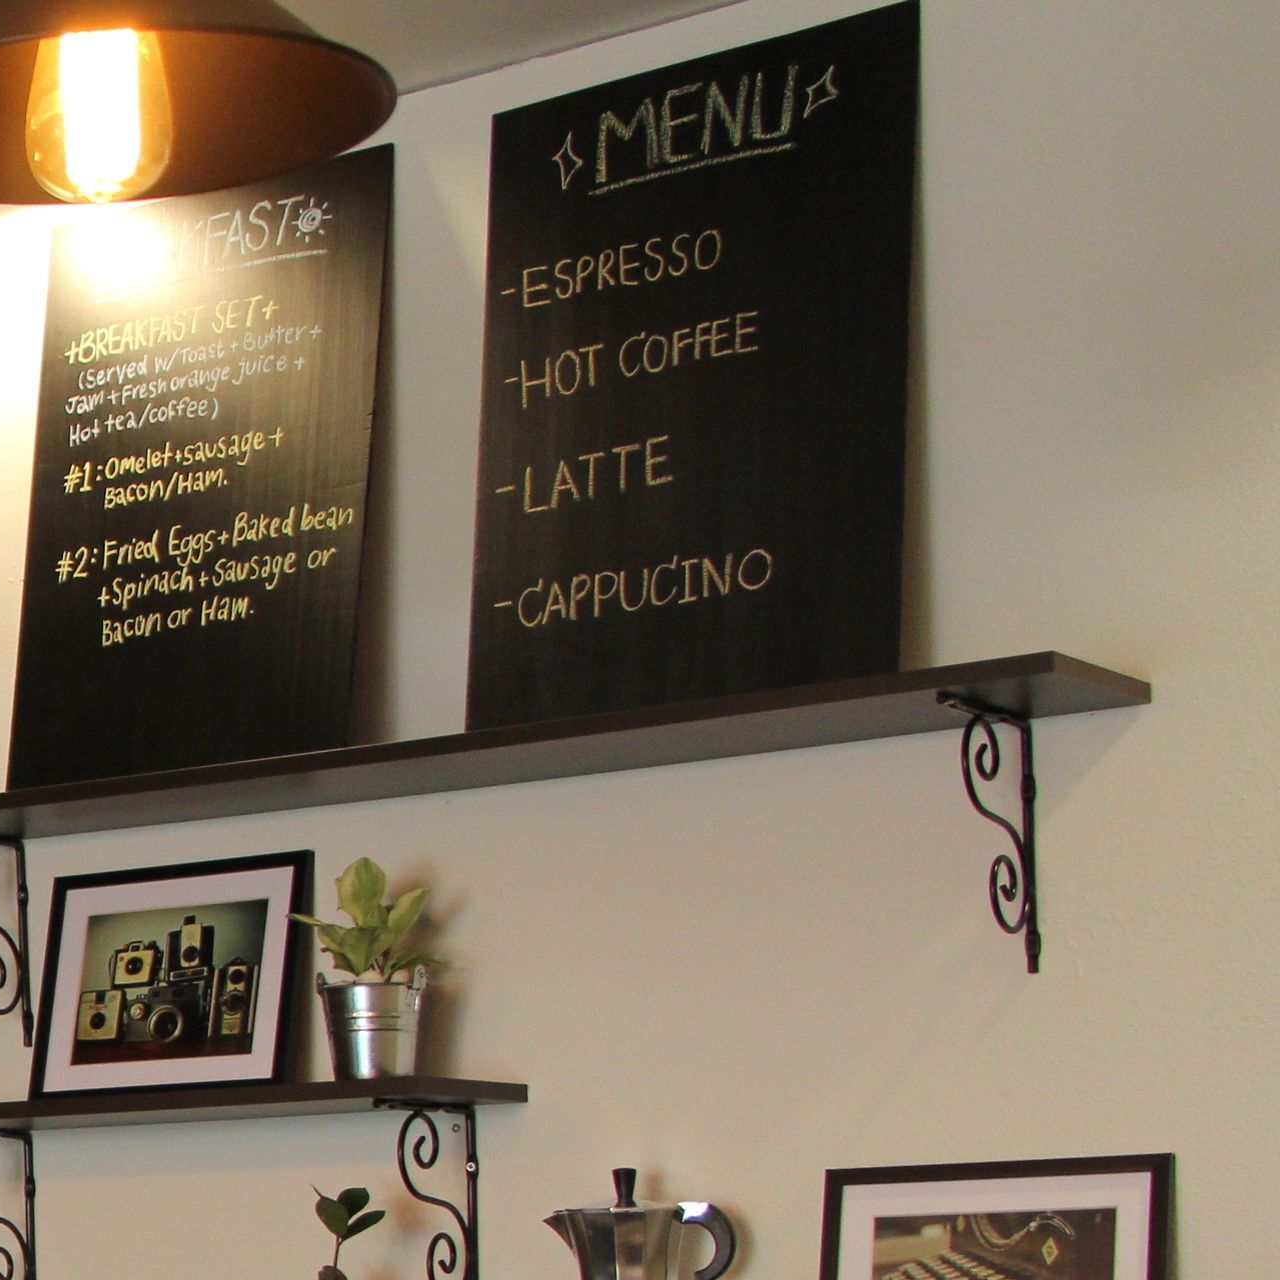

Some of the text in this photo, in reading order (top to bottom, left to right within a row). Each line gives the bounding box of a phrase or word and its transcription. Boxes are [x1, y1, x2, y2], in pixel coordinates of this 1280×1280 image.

[595, 64, 798, 184] MENU
[183, 194, 305, 266] FAST
[243, 325, 307, 351] Butter
[619, 311, 759, 378] COFFEE
[170, 366, 230, 392] orange
[69, 418, 100, 447] Hot
[102, 529, 160, 570] Fried
[300, 503, 354, 531] bean
[307, 547, 337, 569] or
[102, 595, 255, 647] Bacon or Ham.
